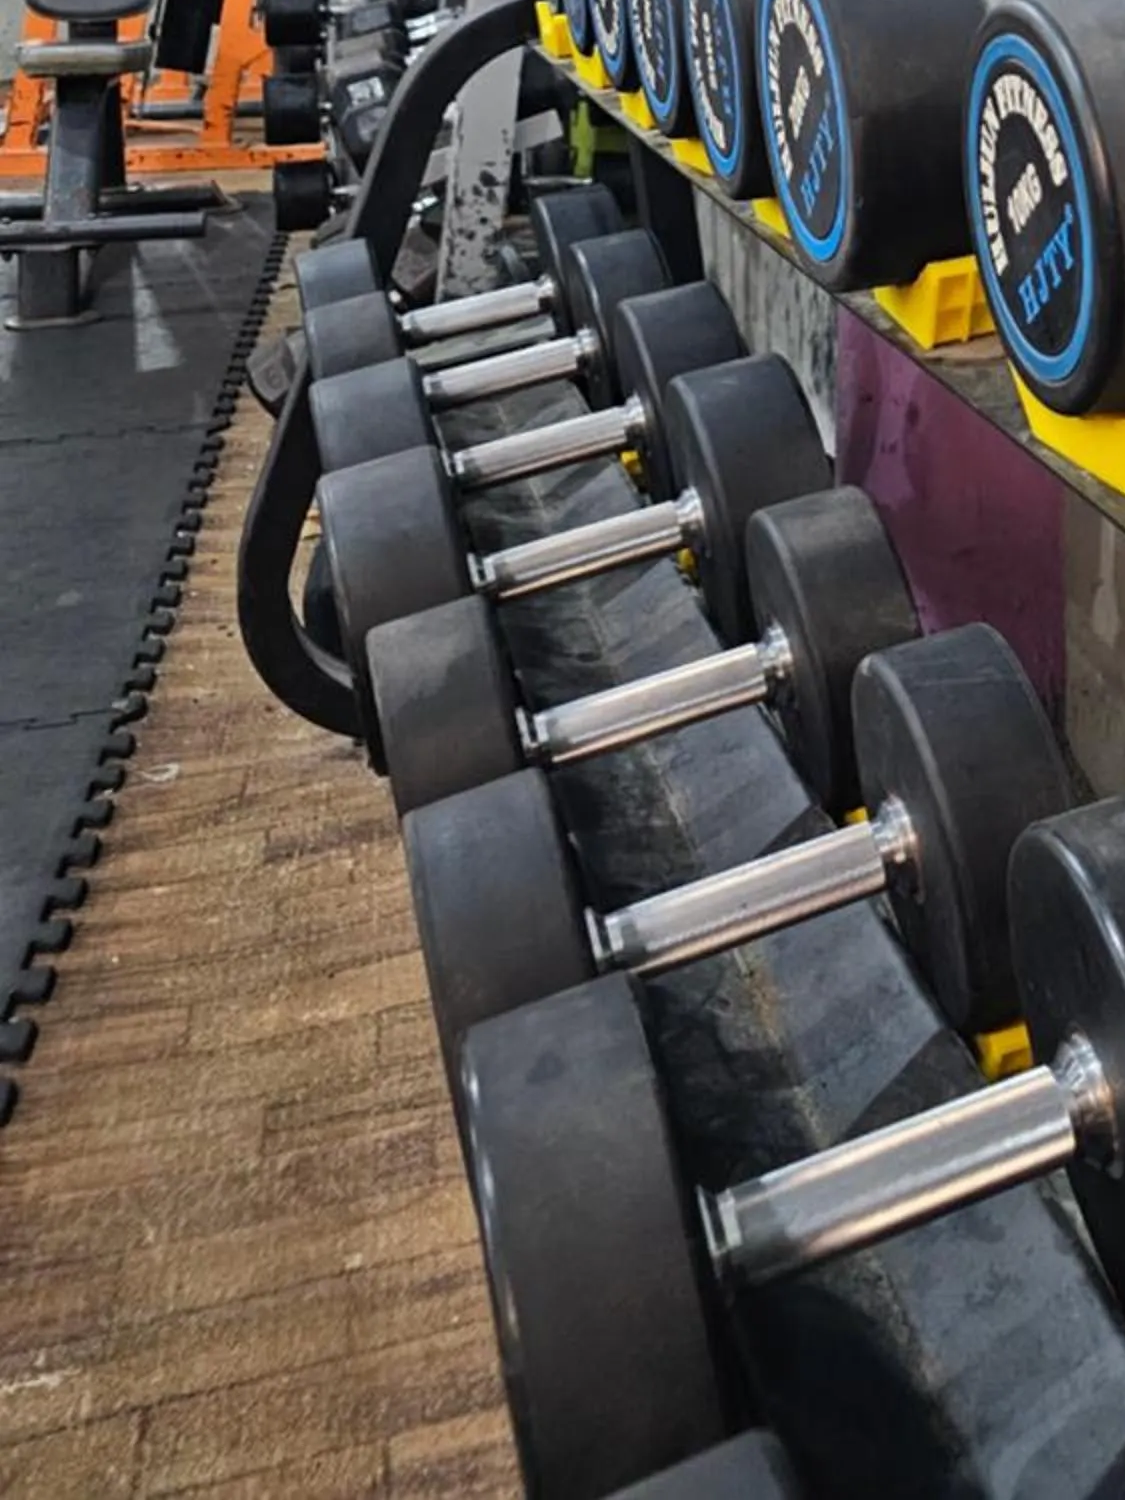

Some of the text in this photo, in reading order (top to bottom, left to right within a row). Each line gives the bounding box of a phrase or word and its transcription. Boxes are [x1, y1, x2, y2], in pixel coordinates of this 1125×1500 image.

[993, 73, 1067, 186] FITNESS
[1007, 162, 1042, 234] 10KG
[1017, 219, 1075, 324] HJTY
